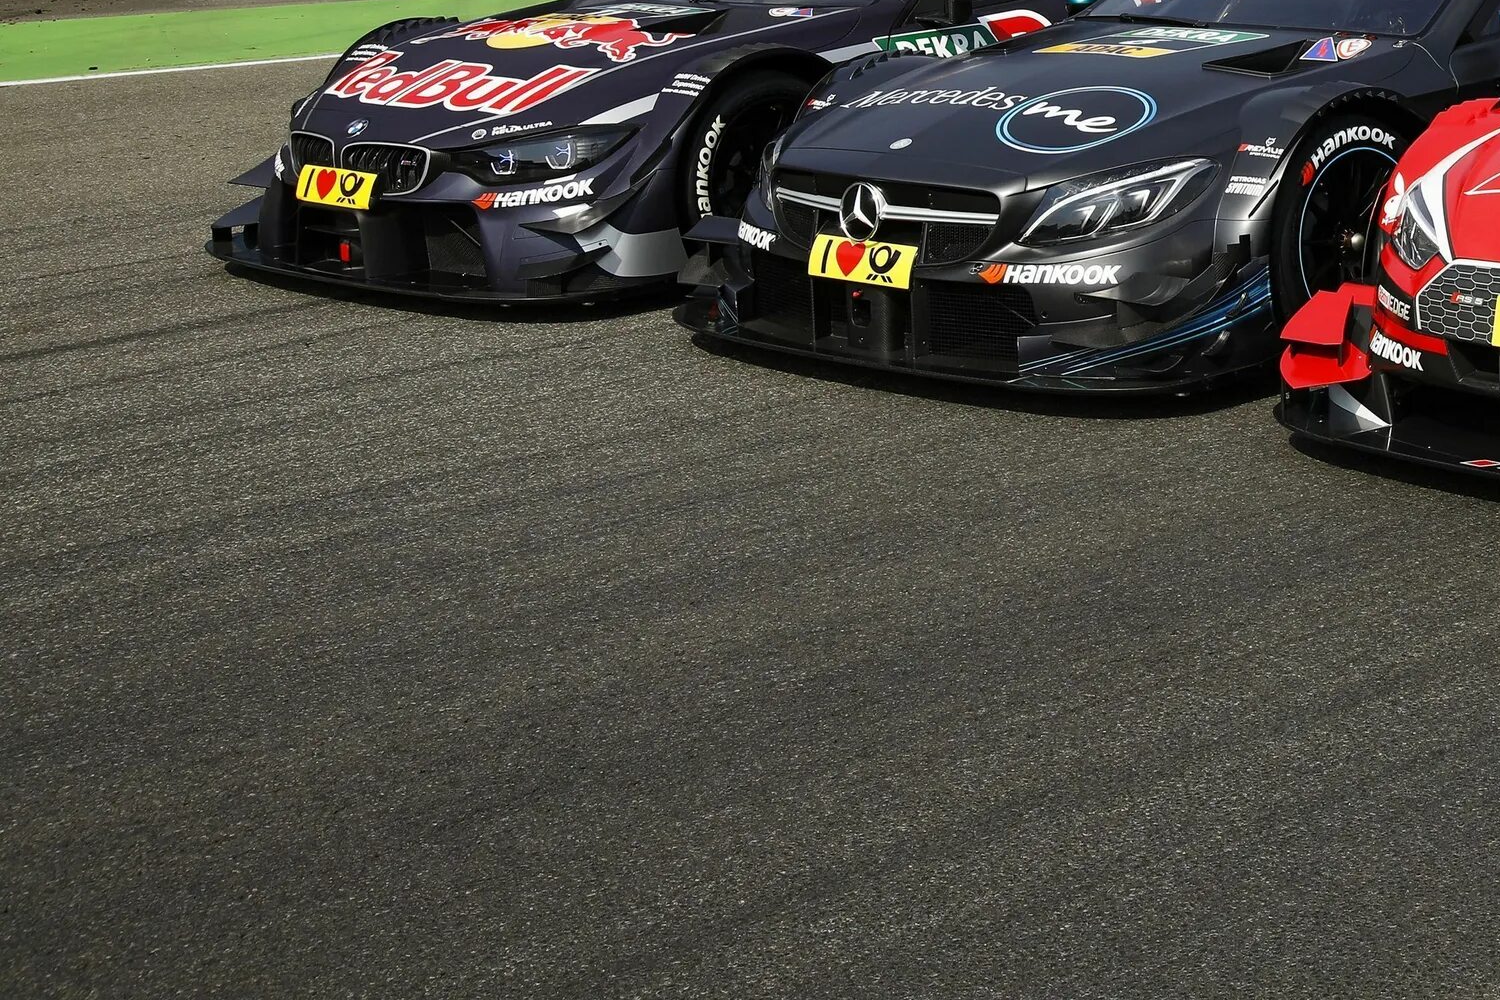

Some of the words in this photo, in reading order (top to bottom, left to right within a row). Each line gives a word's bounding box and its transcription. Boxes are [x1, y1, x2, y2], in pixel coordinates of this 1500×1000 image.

[1131, 28, 1238, 42] DEKRA
[326, 50, 463, 105] Red
[386, 60, 602, 113] Bull
[839, 85, 1031, 111] Mercedes
[1023, 100, 1118, 134] me
[1230, 175, 1267, 184] PETRONAS
